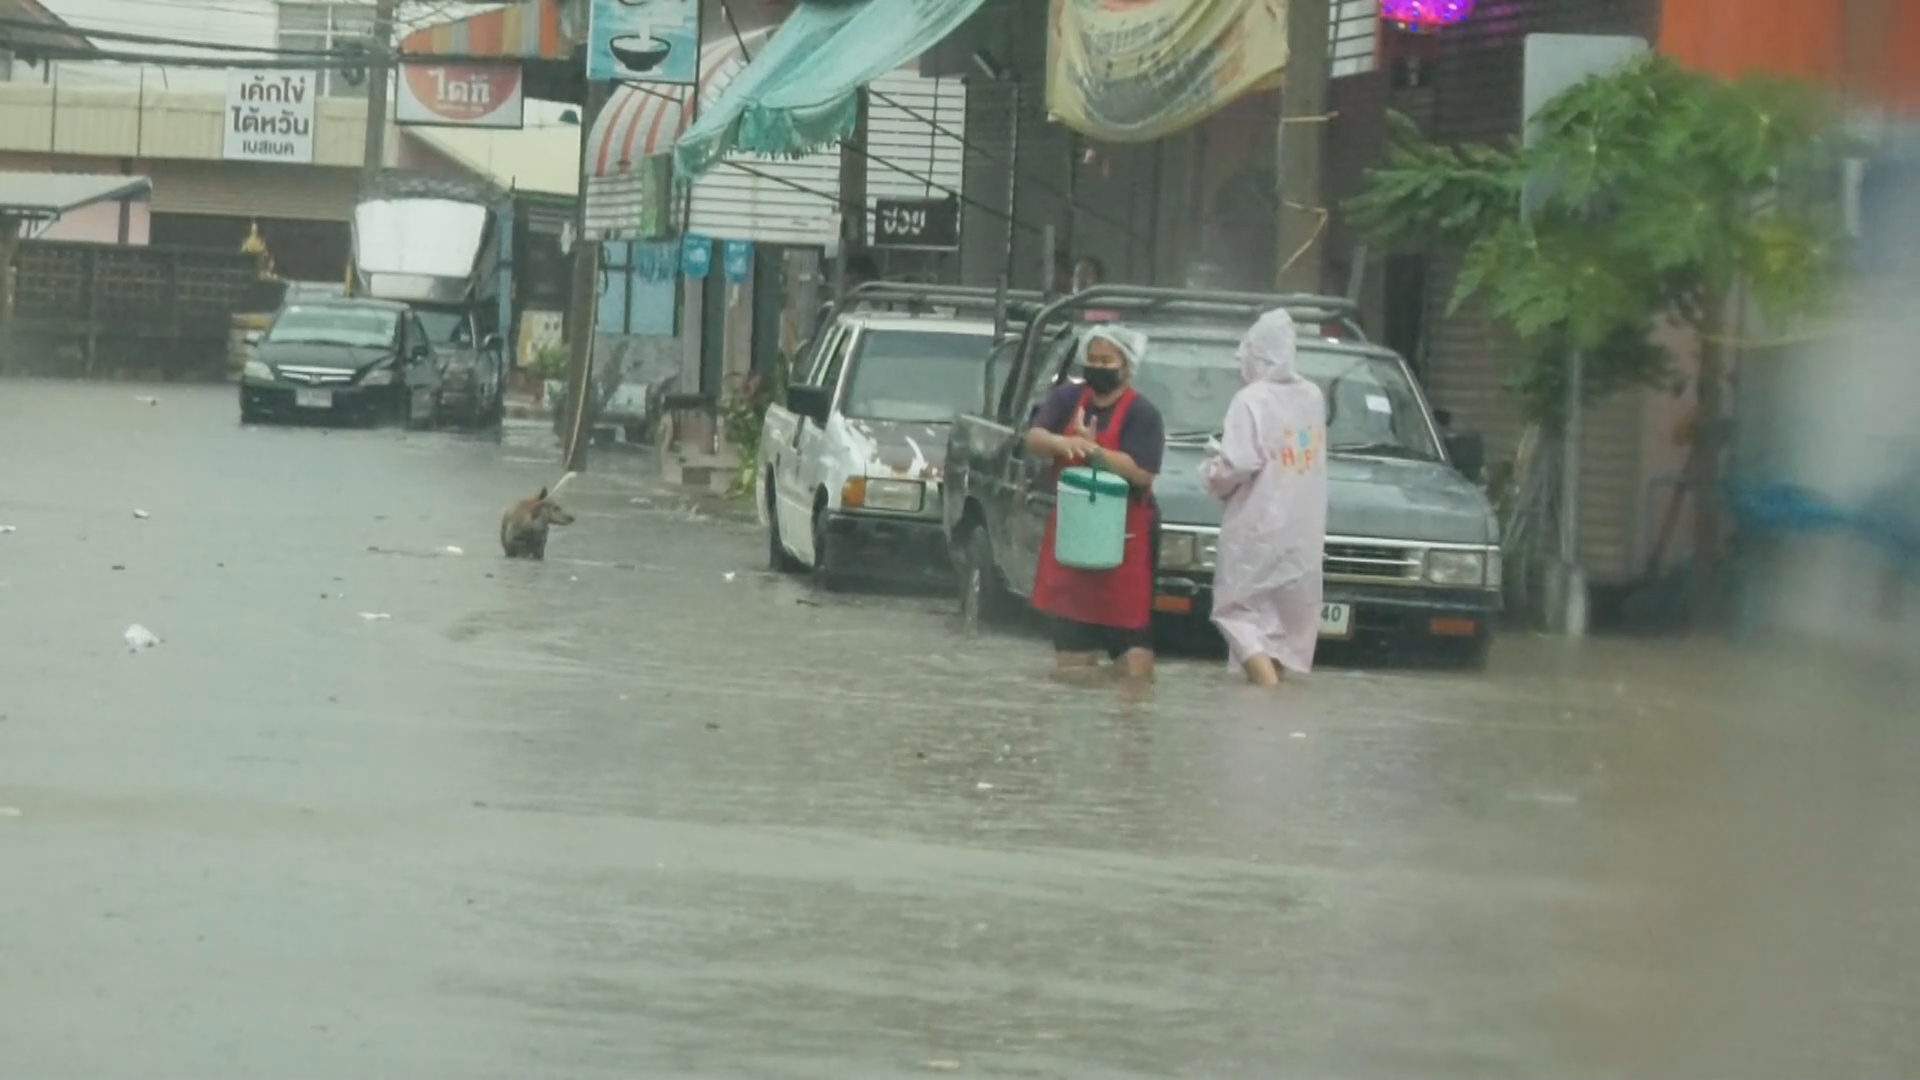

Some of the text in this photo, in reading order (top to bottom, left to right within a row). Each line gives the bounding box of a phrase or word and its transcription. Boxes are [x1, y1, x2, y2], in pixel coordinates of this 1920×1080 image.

[240, 75, 305, 103] เค้กไข่
[231, 106, 309, 136] ไต้หวัน
